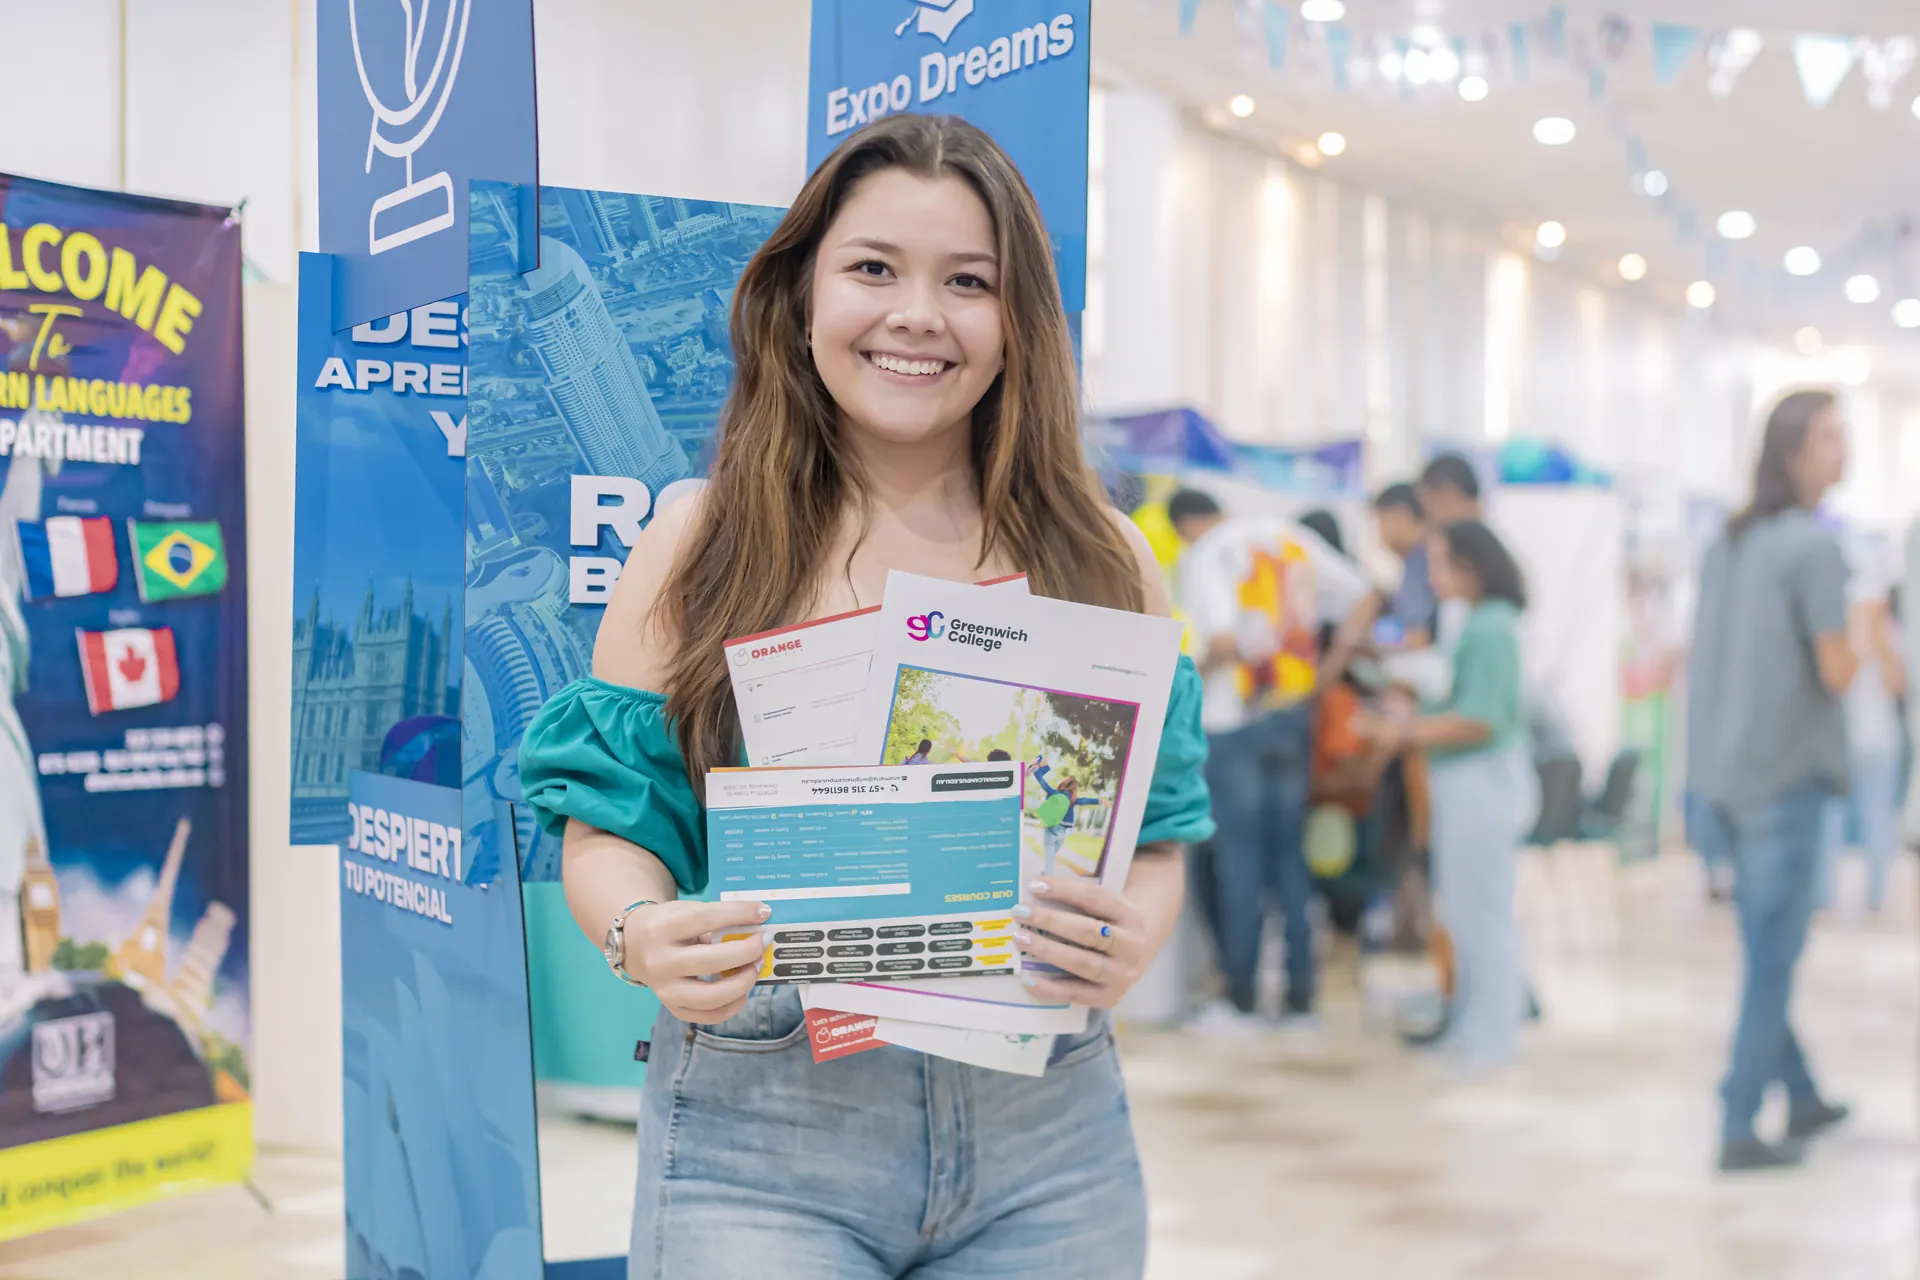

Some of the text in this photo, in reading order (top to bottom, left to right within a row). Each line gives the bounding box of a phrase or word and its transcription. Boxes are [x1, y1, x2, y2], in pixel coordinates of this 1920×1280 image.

[826, 13, 1074, 136] Expo Dreams
[352, 301, 468, 348] DE
[314, 357, 468, 396] APRE
[35, 374, 191, 424] LANGUAGES
[0, 418, 143, 465] PARTMENT
[570, 475, 711, 547] R
[751, 639, 802, 659] ORANGE
[948, 631, 1003, 652] College
[950, 618, 1028, 642] Greenwich
[812, 786, 849, 794] 8611644
[344, 860, 453, 924] TU POTENCIAL
[944, 890, 1013, 903] OUR COURSES
[831, 1018, 877, 1037] ORANGE
